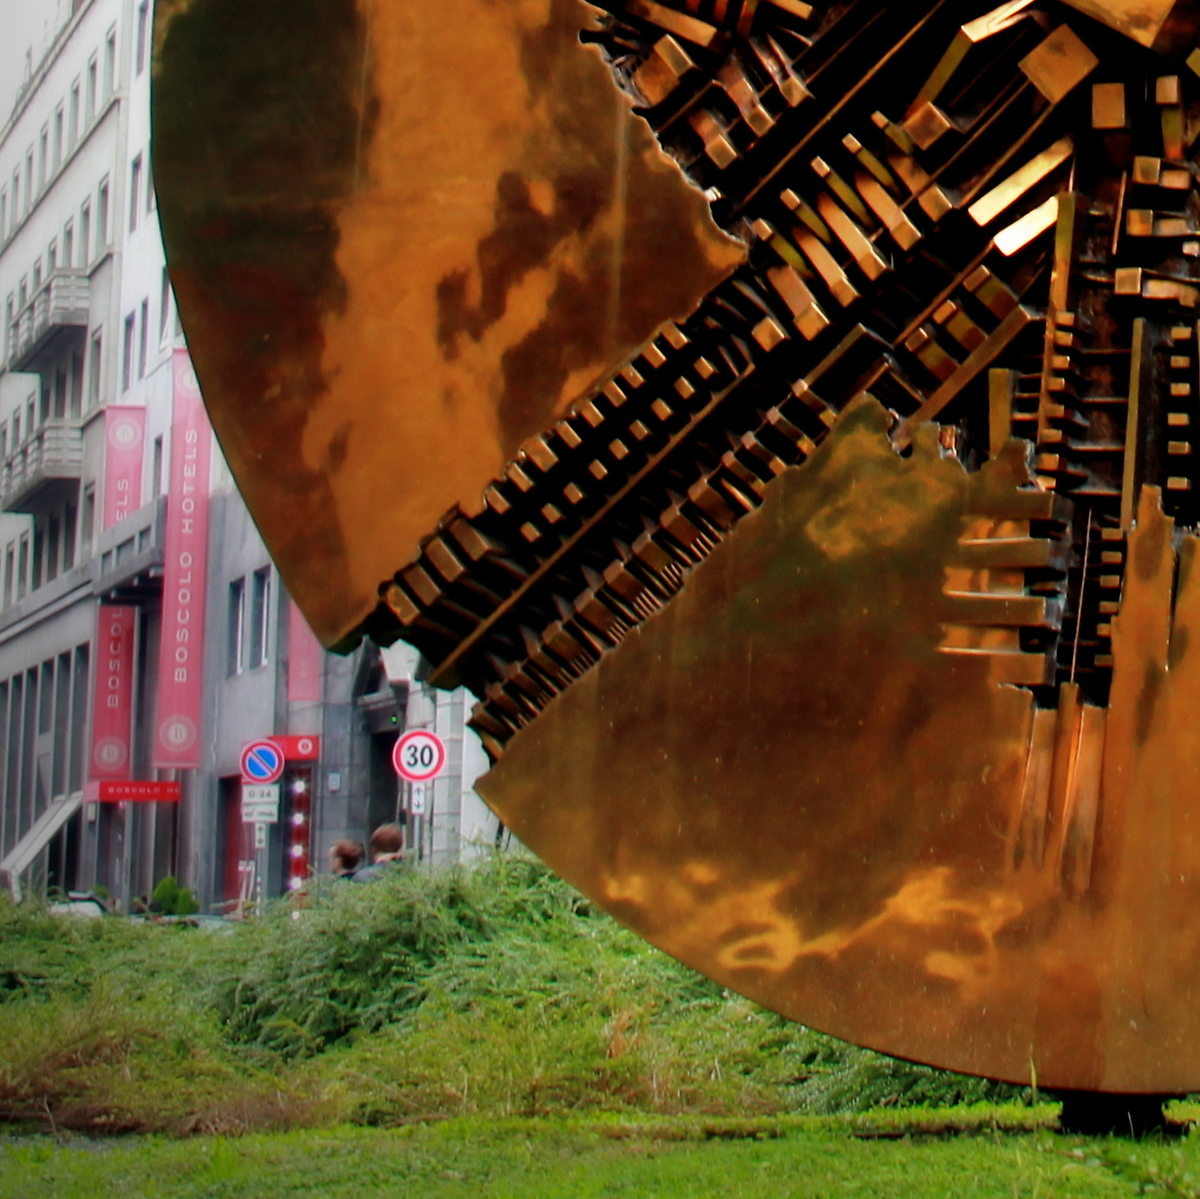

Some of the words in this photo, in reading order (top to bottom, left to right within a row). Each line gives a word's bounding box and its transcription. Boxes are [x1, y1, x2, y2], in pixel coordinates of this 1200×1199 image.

[181, 429, 198, 534] HOTELS
[174, 551, 193, 683] BOSCOLO
[406, 744, 434, 768] 30
[108, 786, 161, 794] BOSCOLO
